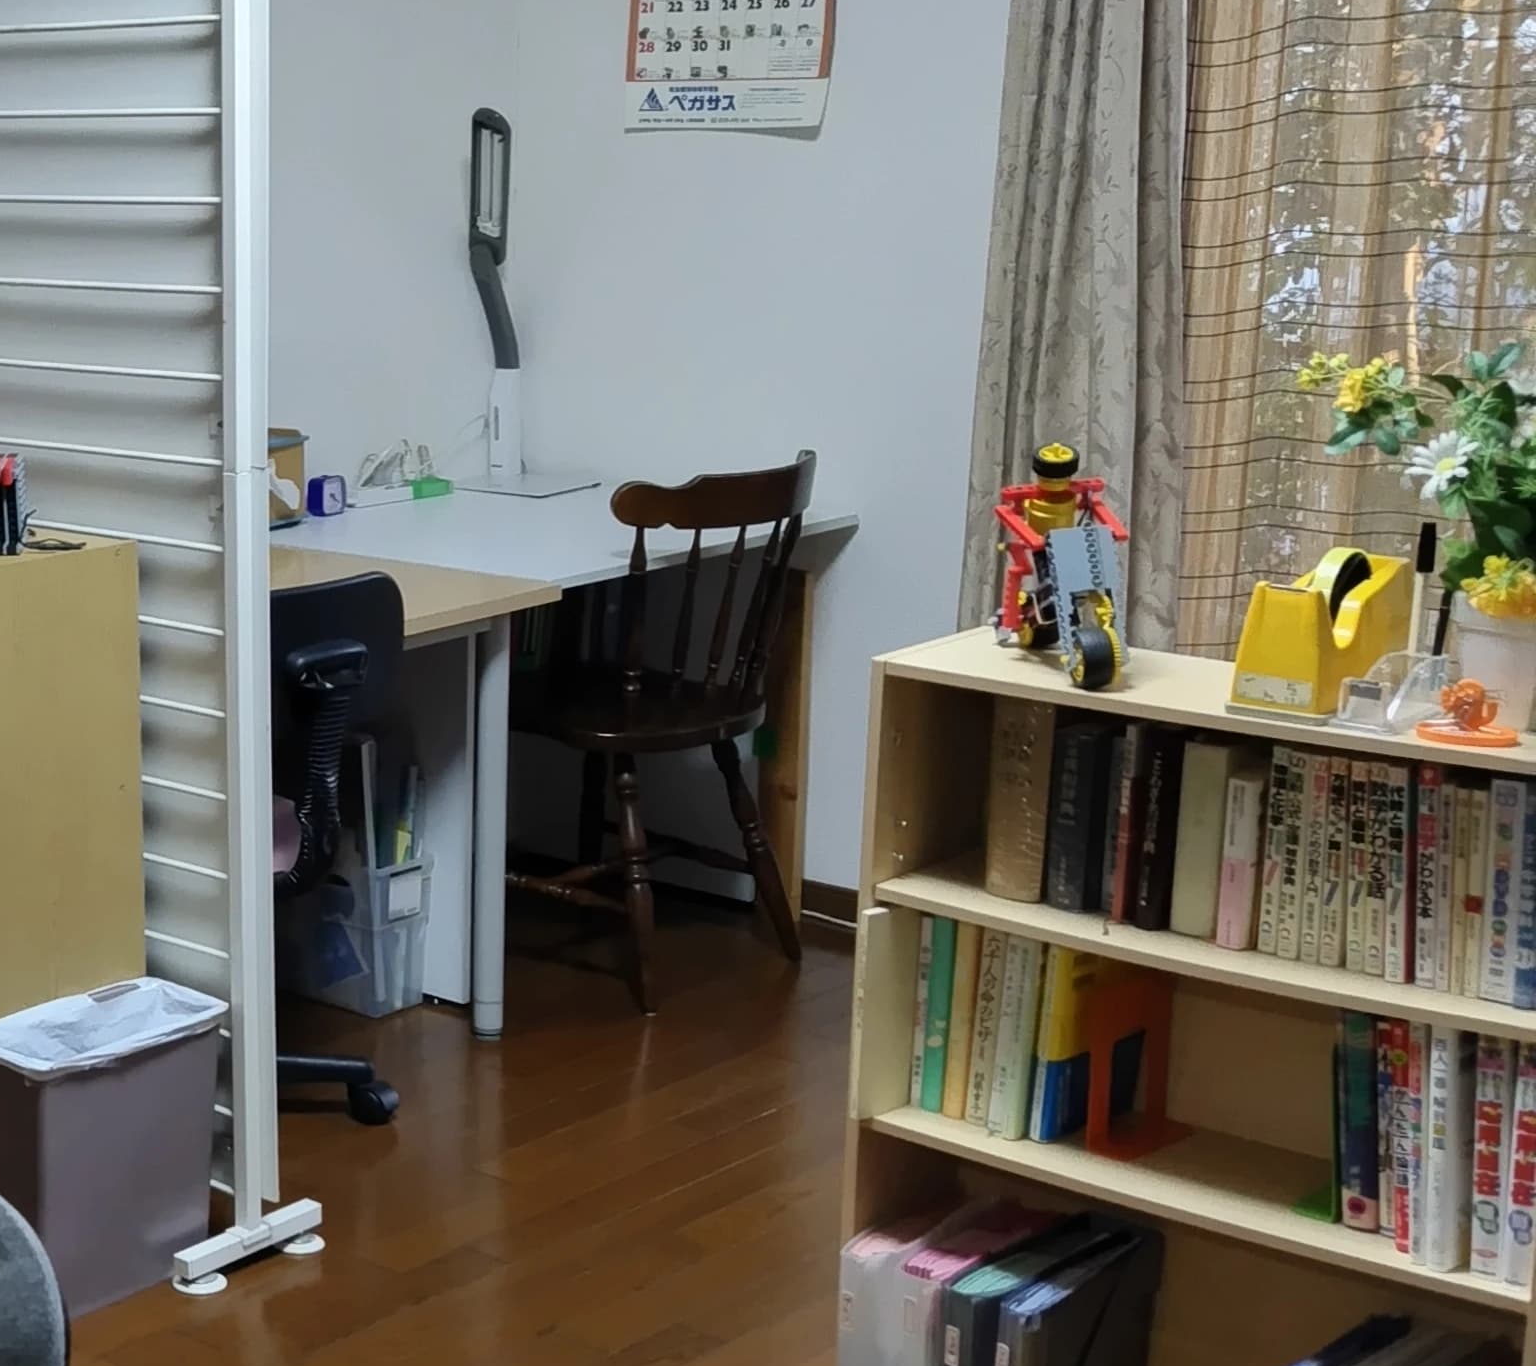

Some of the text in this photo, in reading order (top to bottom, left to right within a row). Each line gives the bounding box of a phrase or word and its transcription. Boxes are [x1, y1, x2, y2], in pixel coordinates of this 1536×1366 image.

[641, 1, 654, 13] 21
[667, 1, 683, 12] 22
[694, 0, 710, 11] 23
[638, 39, 731, 53] 28 29 30 31
[668, 93, 736, 111] ペガサス
